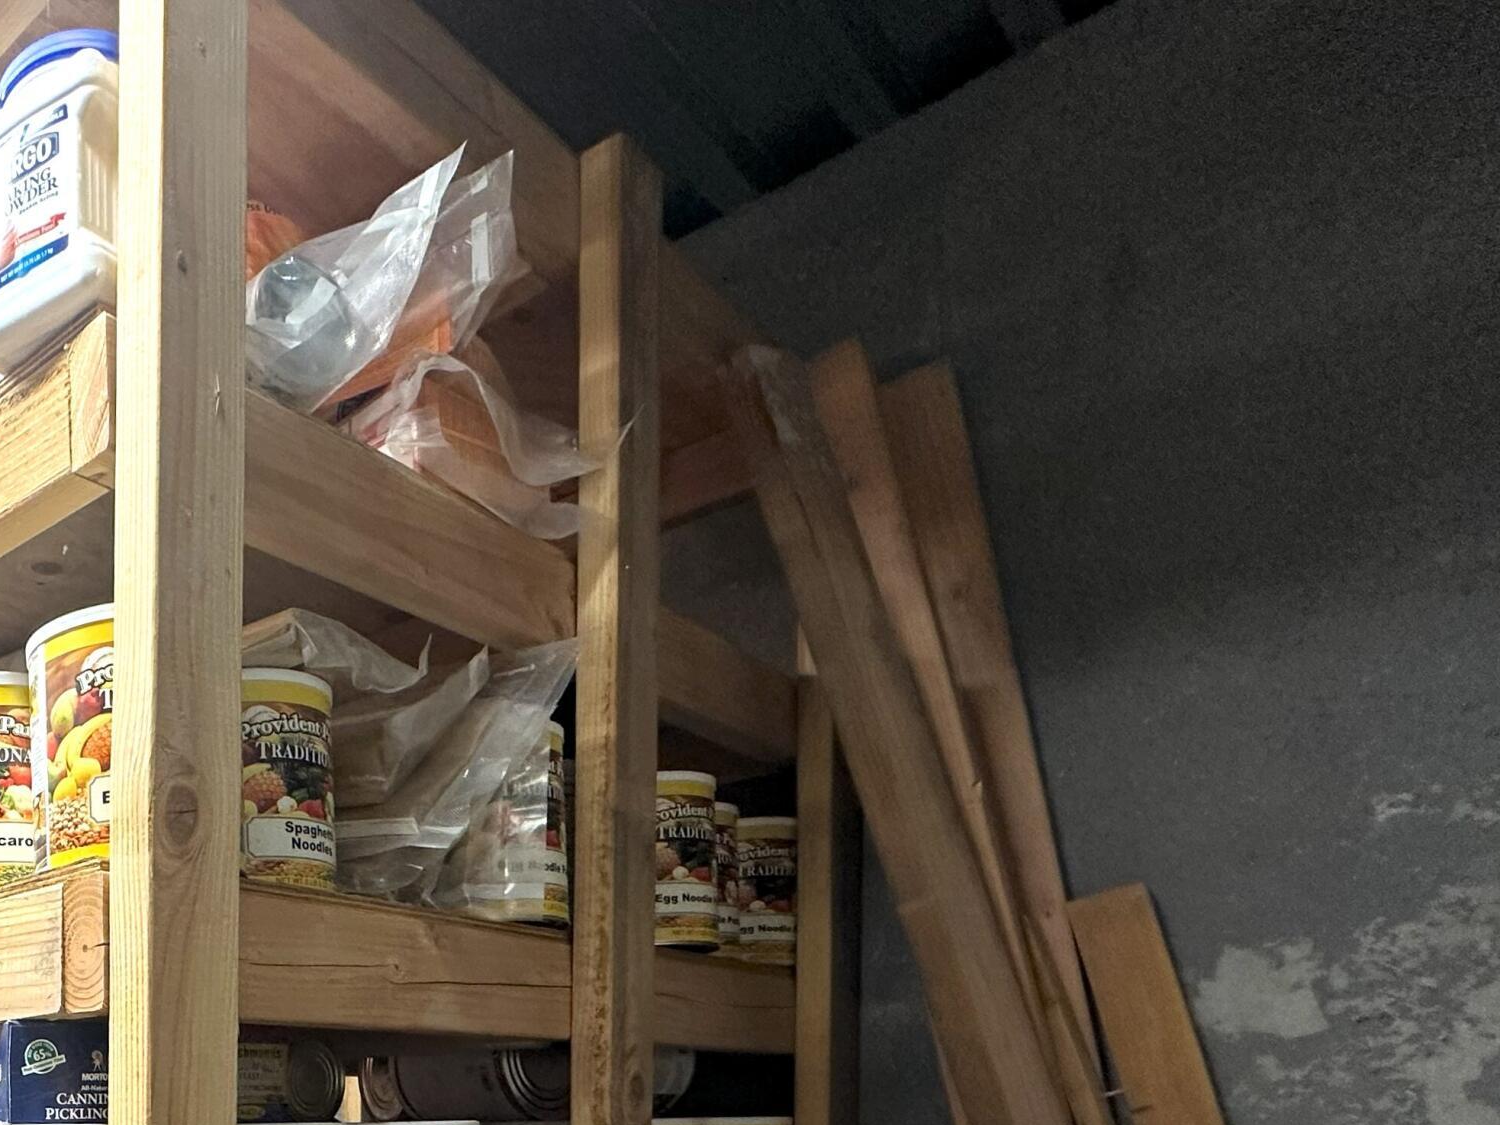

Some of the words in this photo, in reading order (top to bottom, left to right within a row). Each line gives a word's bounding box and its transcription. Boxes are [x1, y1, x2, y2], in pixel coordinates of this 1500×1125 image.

[5, 177, 59, 216] OWDER
[242, 712, 321, 741] Provident
[291, 836, 333, 857] Noodles
